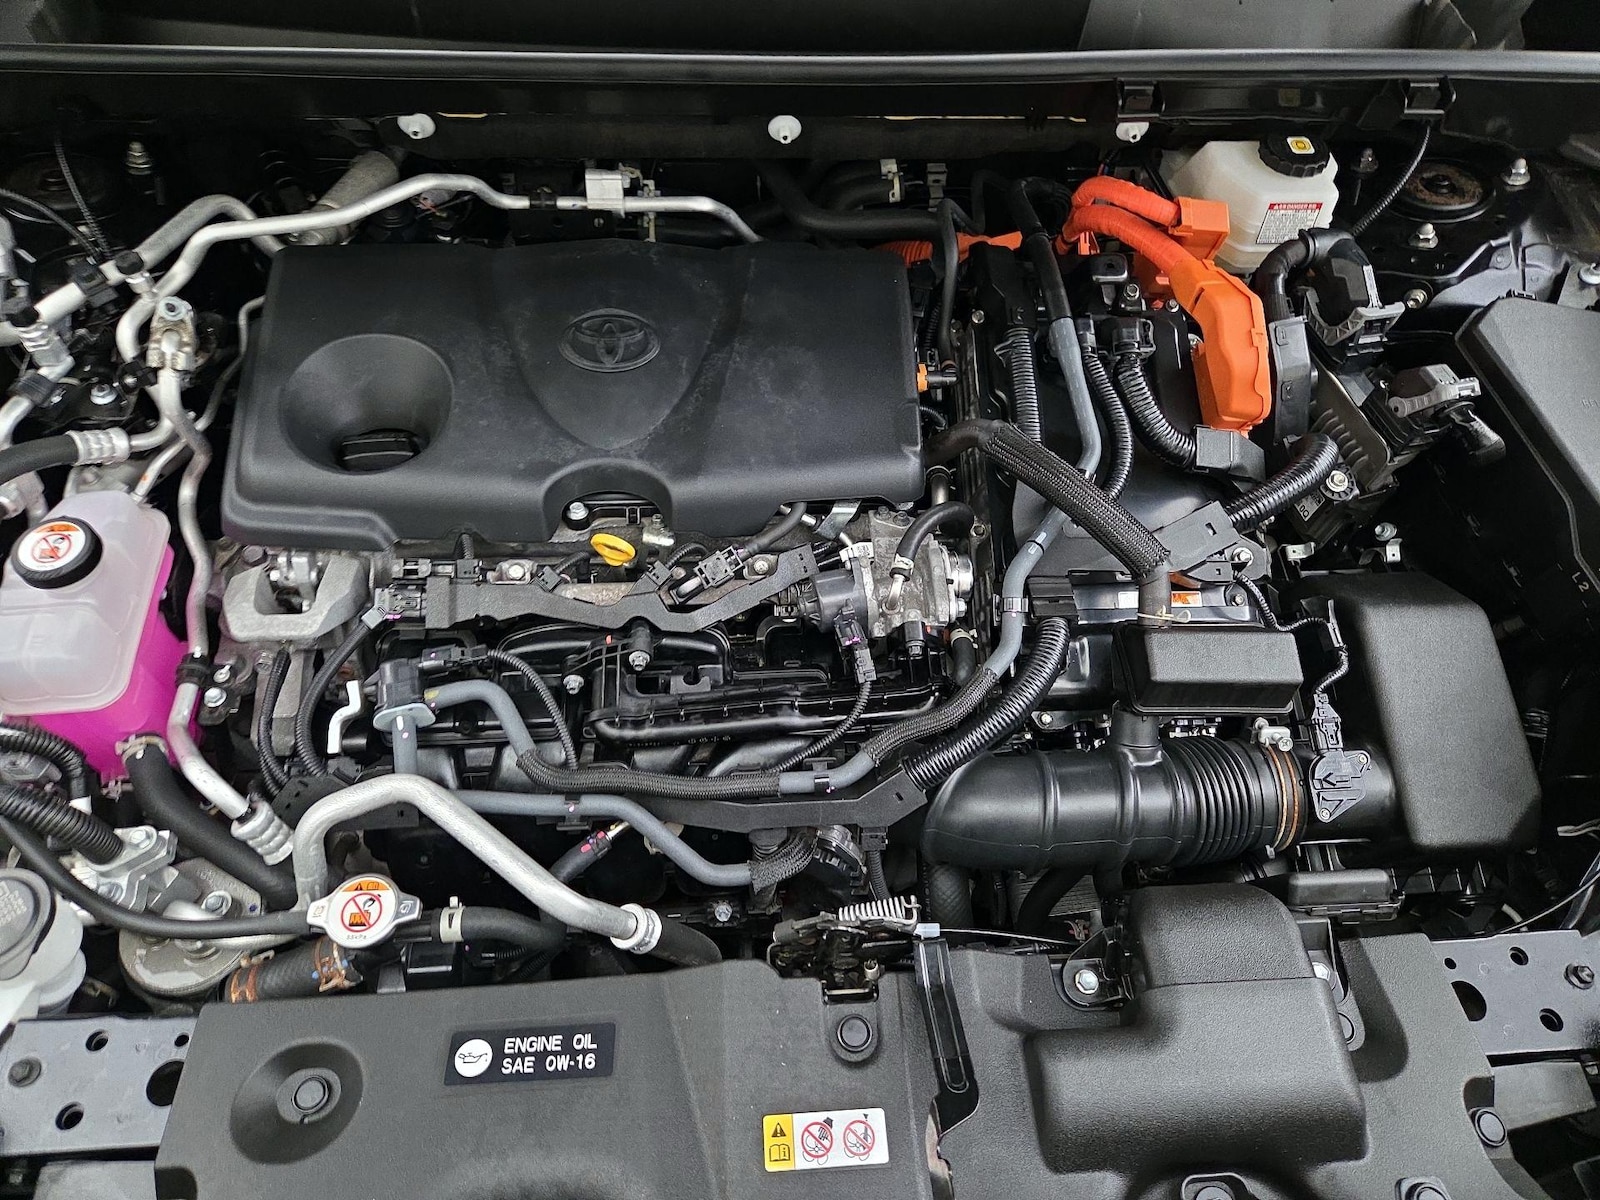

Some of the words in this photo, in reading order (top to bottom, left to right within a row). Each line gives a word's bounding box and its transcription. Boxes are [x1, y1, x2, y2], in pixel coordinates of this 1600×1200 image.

[504, 1034, 563, 1054] ENGINE
[572, 1033, 598, 1050] OIL
[501, 1056, 535, 1074] SAE
[545, 1053, 596, 1072] 0W-16
